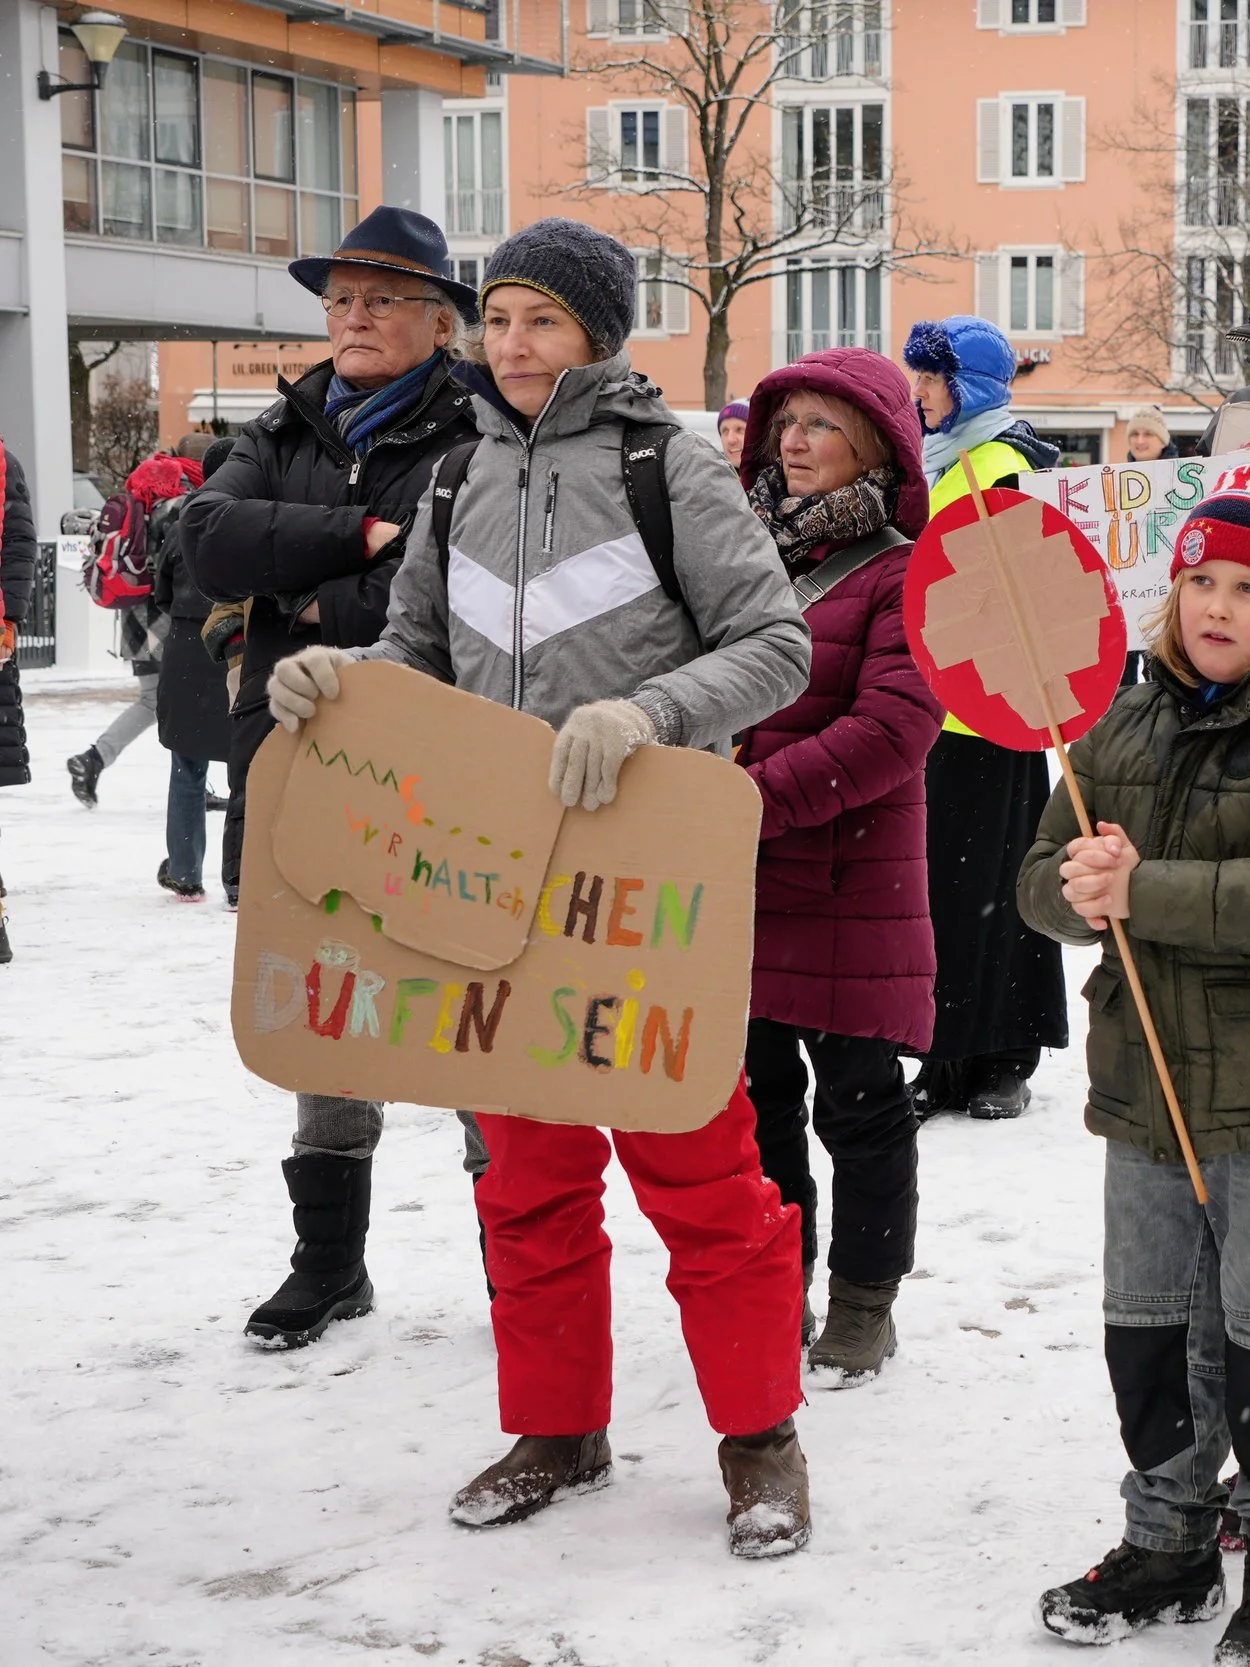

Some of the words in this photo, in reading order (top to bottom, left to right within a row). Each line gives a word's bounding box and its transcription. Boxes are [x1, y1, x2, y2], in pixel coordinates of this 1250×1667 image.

[249, 363, 278, 375] GREEN
[283, 363, 314, 375] KITCH
[62, 541, 77, 552] vhs
